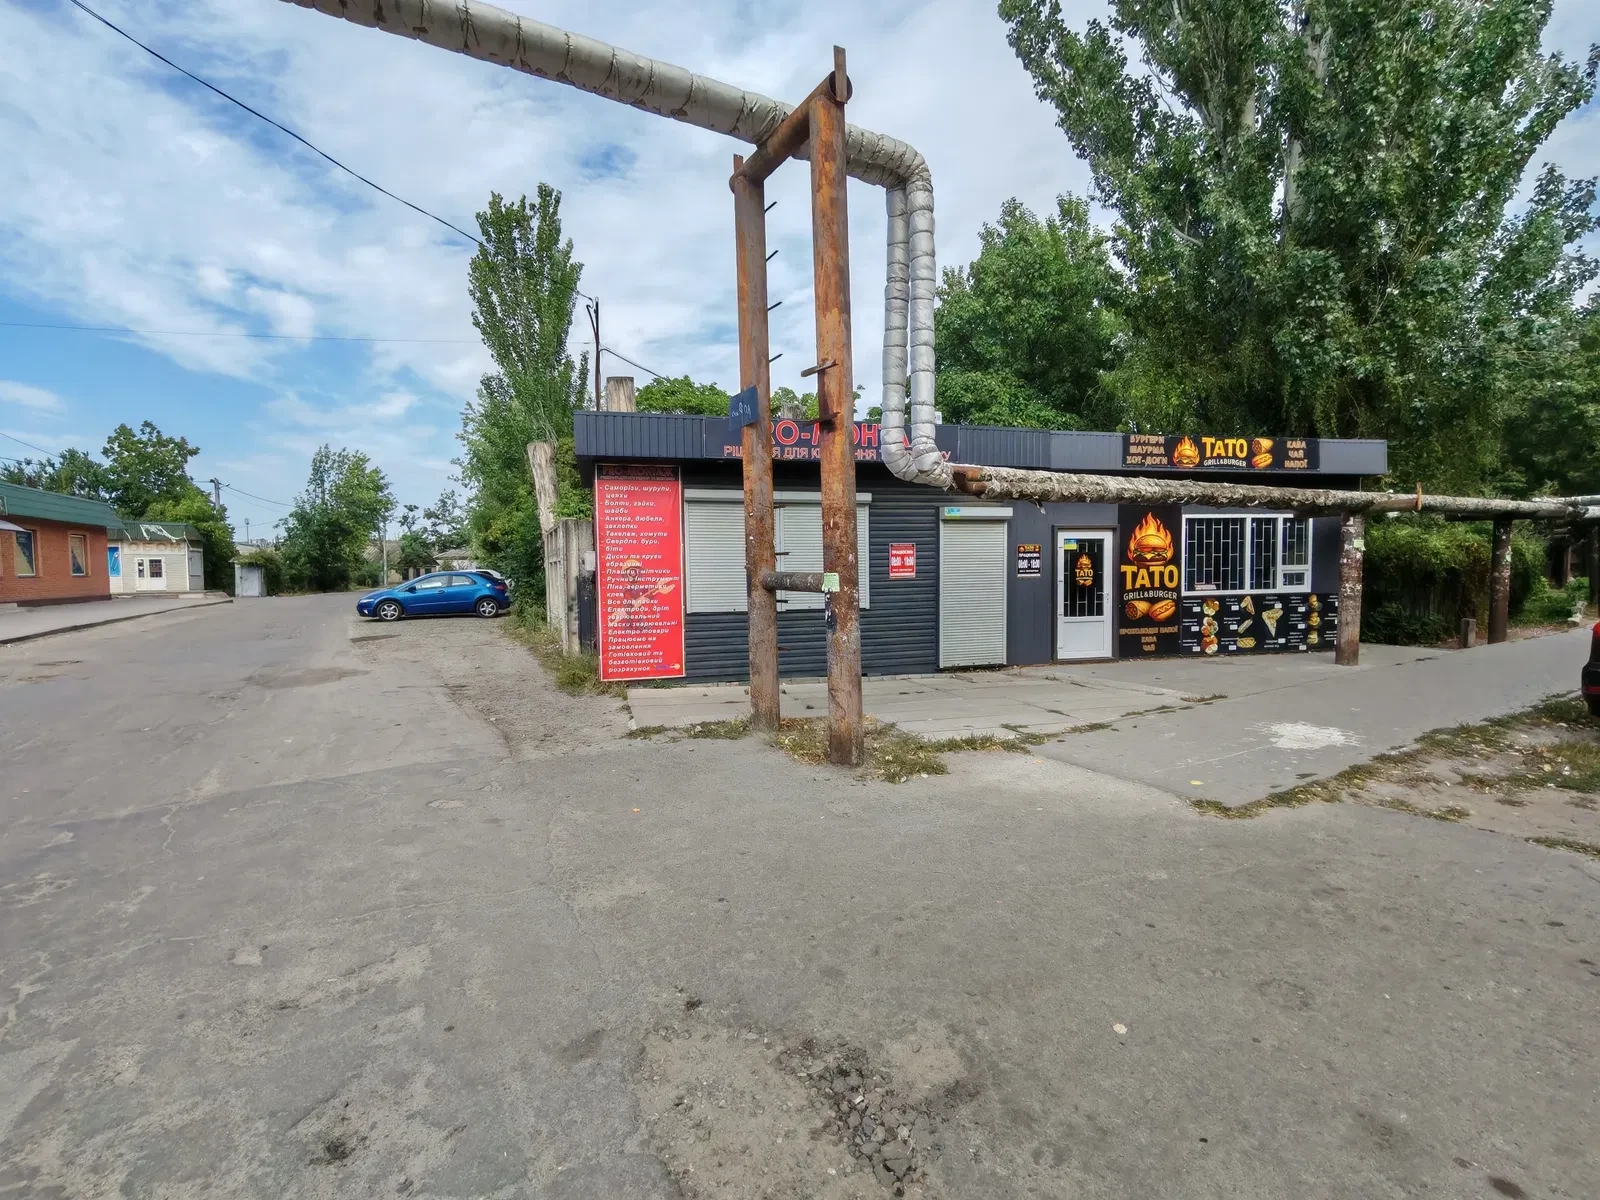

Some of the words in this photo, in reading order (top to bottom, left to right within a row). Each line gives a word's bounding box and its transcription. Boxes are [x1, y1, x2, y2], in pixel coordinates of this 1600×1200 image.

[783, 446, 809, 459] ДЛЯ
[1129, 445, 1165, 454] ШАУРМА
[1203, 458, 1247, 468] GRILL&BURGER
[604, 484, 641, 492] Саморізи,
[604, 499, 632, 507] Болти,
[641, 538, 660, 546] бури,
[1123, 590, 1178, 601] GRILL&BURGER
[608, 666, 651, 674] розрахунок
